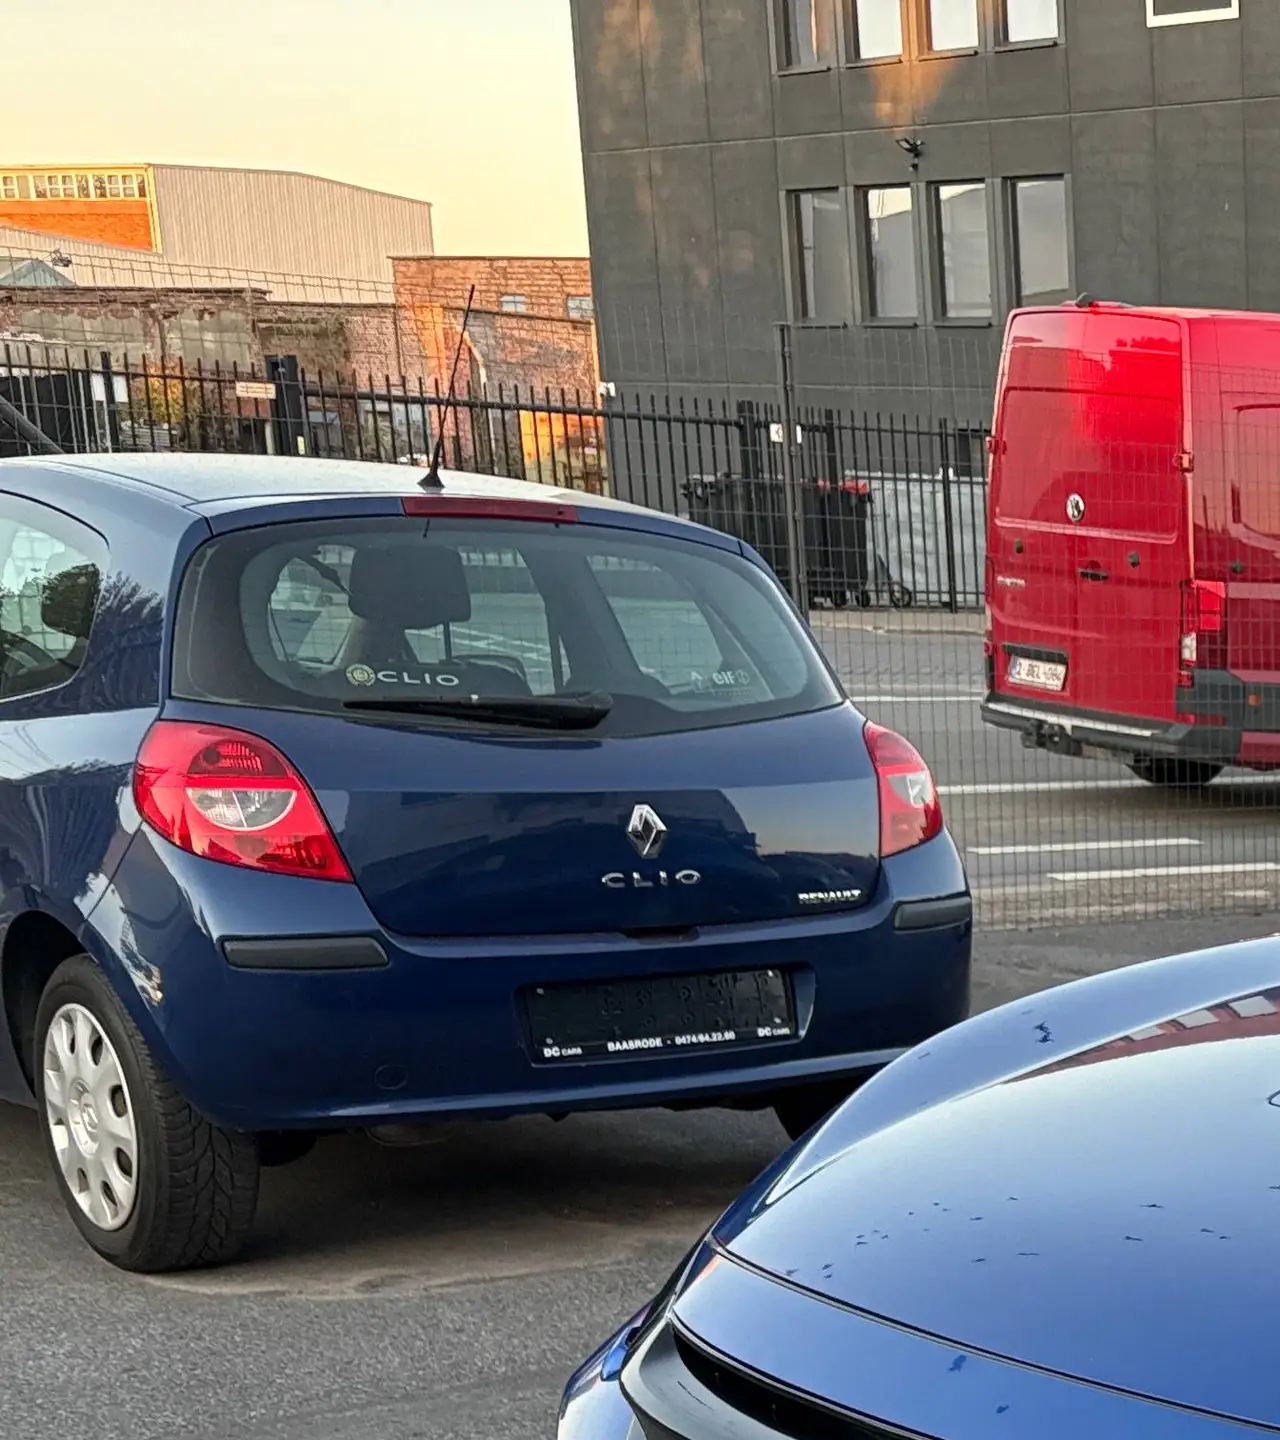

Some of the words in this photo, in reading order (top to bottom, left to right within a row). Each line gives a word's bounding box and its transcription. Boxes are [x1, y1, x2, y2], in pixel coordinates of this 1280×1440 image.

[377, 670, 459, 686] CLIO
[602, 869, 701, 888] CLIO
[798, 889, 862, 904] RENAULT
[543, 1046, 560, 1058] DC
[561, 1047, 582, 1056] CARS
[607, 1037, 663, 1052] BAASRODE
[757, 1027, 772, 1037] DC
